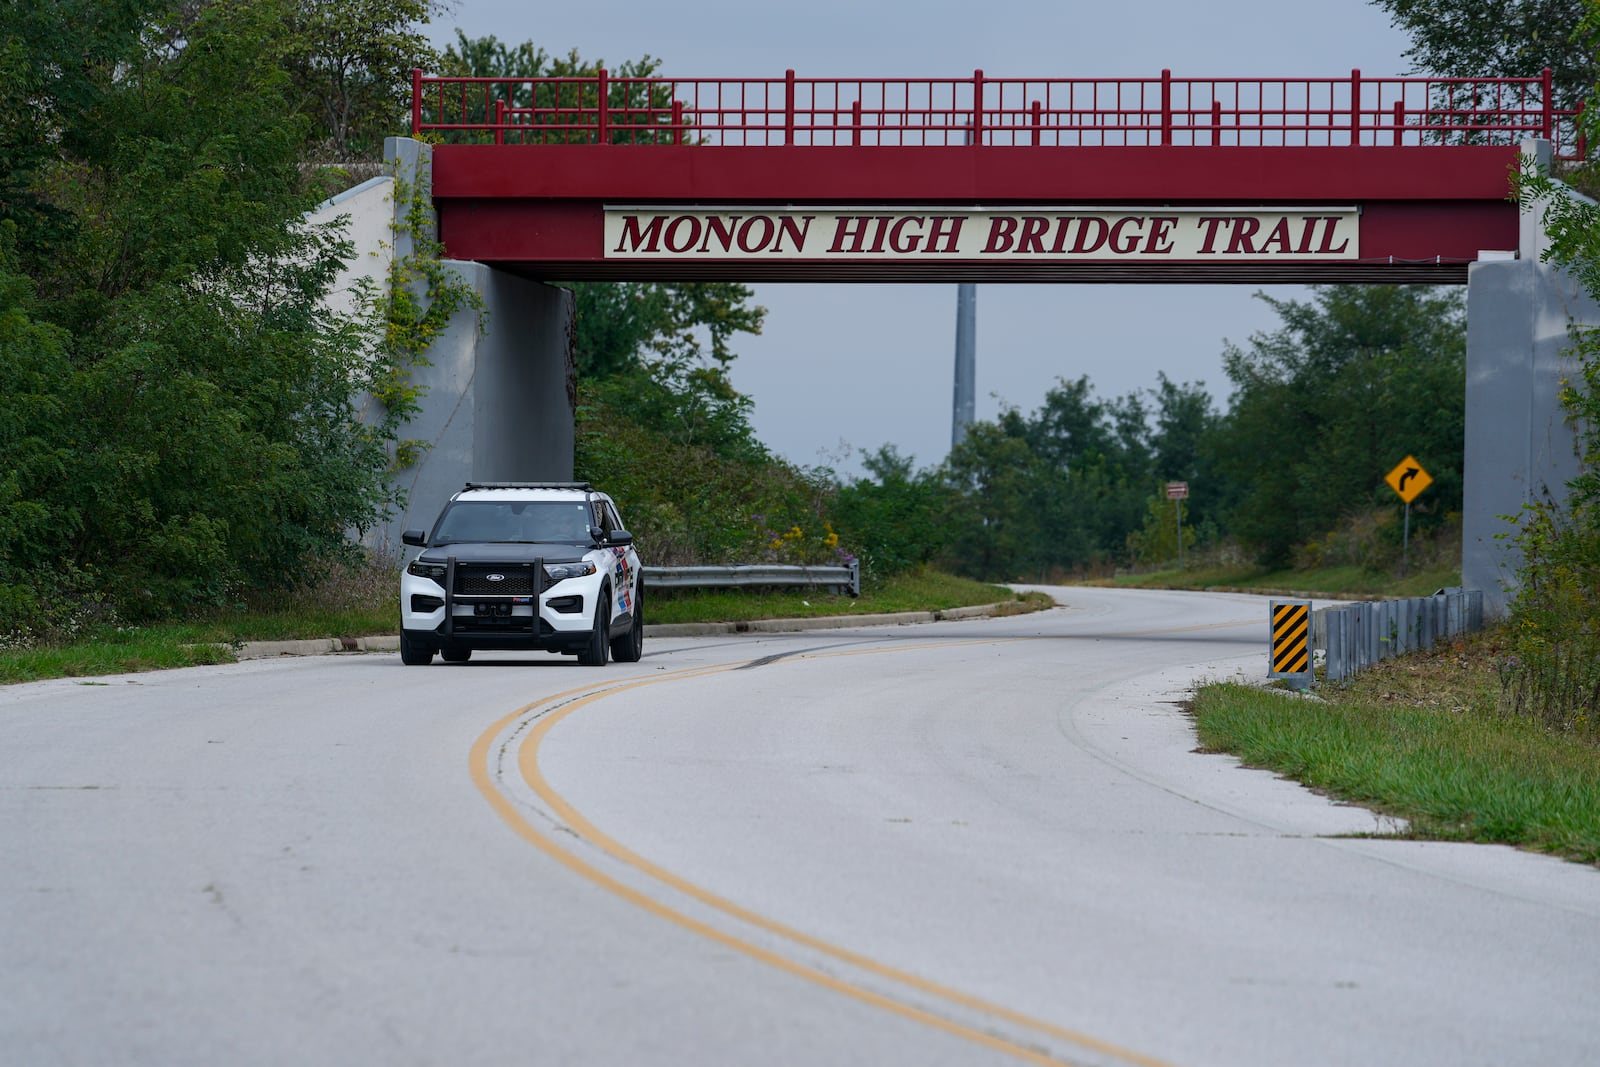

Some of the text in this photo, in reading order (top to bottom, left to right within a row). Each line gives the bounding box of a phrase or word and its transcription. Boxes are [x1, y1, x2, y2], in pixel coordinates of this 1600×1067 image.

[613, 215, 1350, 254] MONON HIGH BRIDGE TRAIL
